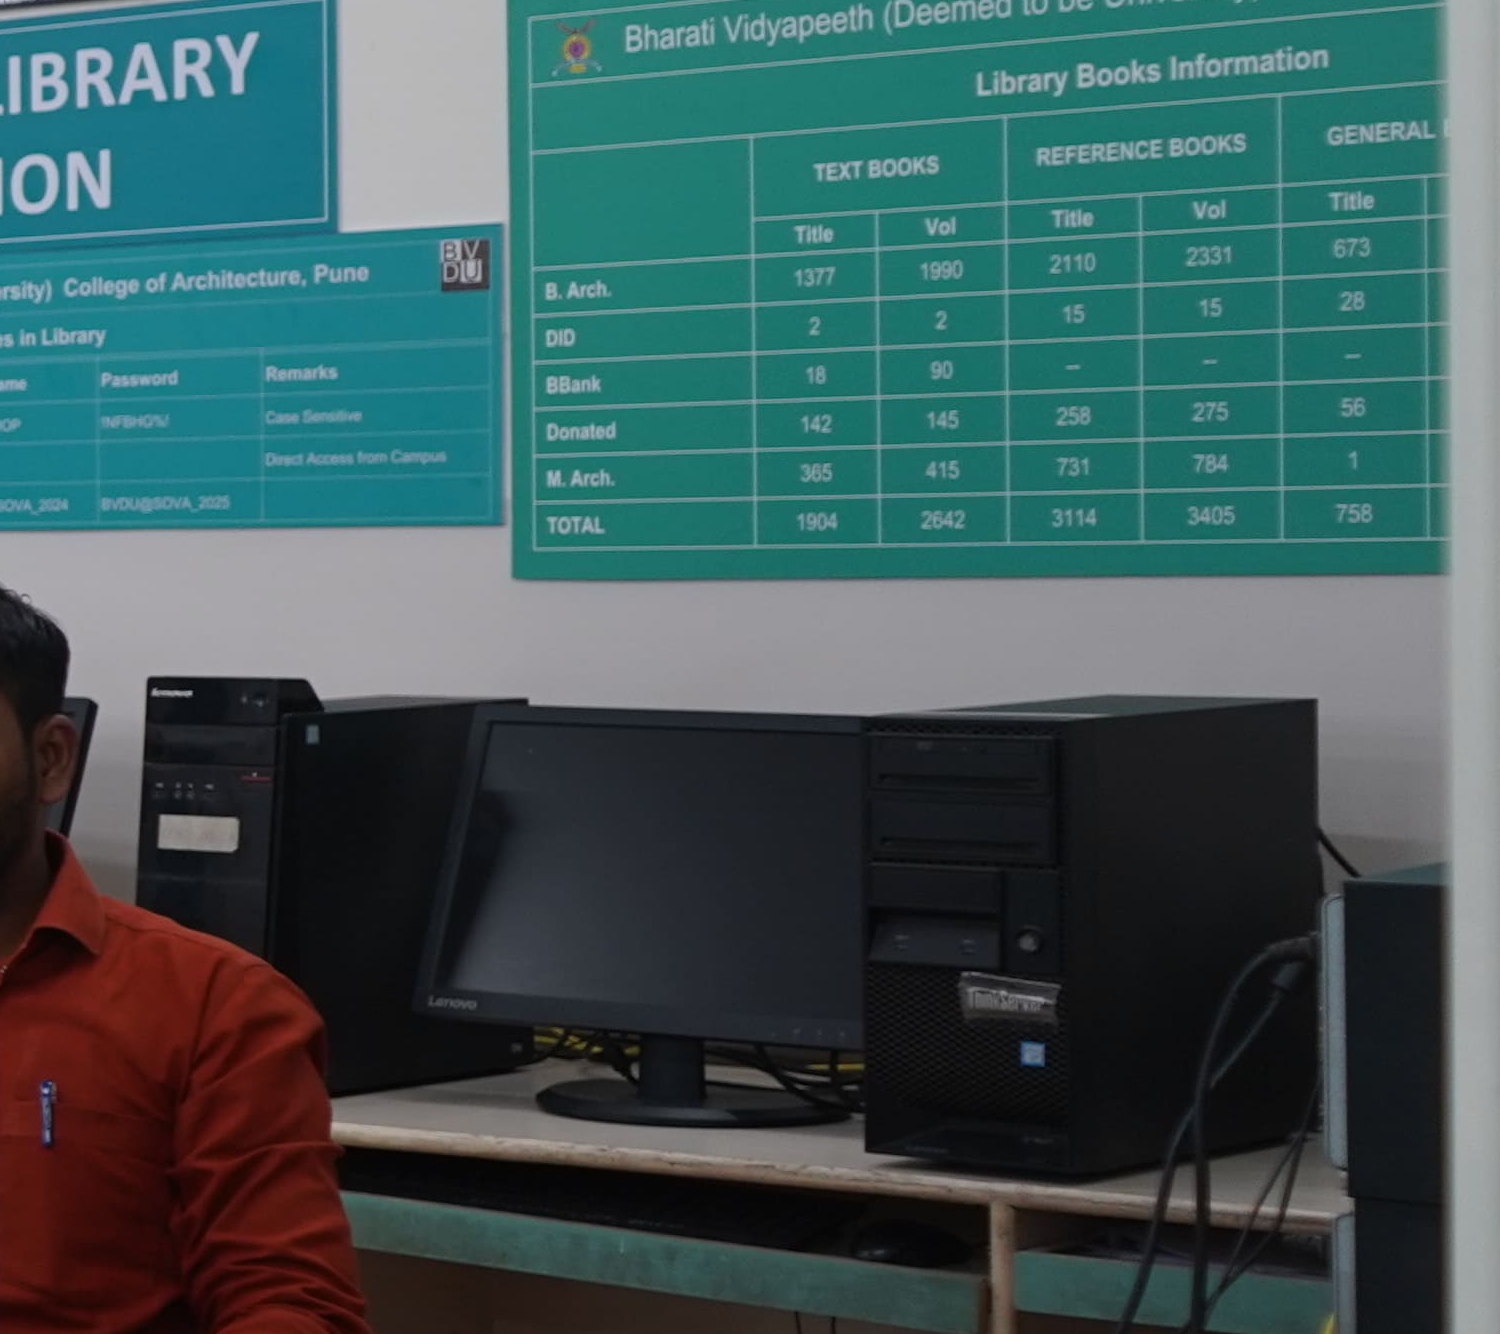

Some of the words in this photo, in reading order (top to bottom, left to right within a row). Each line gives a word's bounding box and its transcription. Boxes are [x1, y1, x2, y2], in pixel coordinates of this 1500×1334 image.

[624, 19, 717, 53] Bharati
[722, 1, 875, 47] Vidyapeeth
[975, 68, 1069, 98] Library
[1076, 59, 1163, 90] Books
[1169, 45, 1331, 82] Information
[1326, 118, 1437, 146] GENERAL
[1035, 138, 1164, 167] REFERENCE
[1168, 132, 1248, 159] BOOKS
[812, 160, 865, 183] TEXT
[867, 155, 941, 180] BOOKS
[1192, 199, 1228, 220] Vol
[1327, 190, 1376, 212] Title
[923, 216, 957, 237] Vol
[1050, 207, 1095, 229] Title
[793, 223, 834, 245] Title
[1185, 245, 1233, 268] 2331
[1332, 237, 1372, 259] 673
[920, 259, 964, 281] 1990
[1049, 252, 1097, 275] 2110
[62, 276, 139, 303] College
[145, 271, 167, 295] of
[170, 265, 308, 292] Architecture,
[313, 262, 370, 285] Pune
[794, 266, 836, 288] 1377
[544, 281, 563, 301] B.
[566, 278, 613, 300] Arch.
[1198, 297, 1223, 319] 15
[1340, 290, 1366, 312] 28
[934, 310, 949, 331] 2
[1062, 304, 1086, 325] 15
[808, 316, 821, 337] 2
[19, 328, 37, 347] in
[41, 326, 107, 351] Library
[544, 328, 576, 348] DID
[101, 370, 179, 389] Password
[265, 364, 339, 383] Remarks
[805, 365, 828, 385] 18
[929, 360, 954, 381] 90
[544, 373, 602, 395] BBank
[265, 408, 299, 425] Case
[301, 406, 362, 424] Sensitive
[1055, 405, 1092, 427] 258
[1191, 400, 1230, 423] 275
[1339, 396, 1367, 418] 56
[799, 414, 833, 435] 142
[926, 409, 960, 430] 145
[545, 421, 617, 442] Donated
[265, 451, 303, 467] Direct
[305, 450, 355, 466] Access
[357, 448, 388, 465] from
[390, 447, 448, 466] Campus
[1056, 457, 1091, 478] 731
[1192, 452, 1230, 474] 784
[1348, 450, 1359, 471] 1
[545, 470, 567, 488] M.
[569, 468, 616, 488] Arch.
[925, 460, 961, 480] 415
[796, 512, 839, 532] 1904
[920, 509, 966, 531] 2642
[1051, 505, 1098, 528] 3114
[1186, 504, 1236, 527] 3405
[1334, 503, 1374, 524] 758
[547, 515, 606, 535] TOTAL
[427, 993, 478, 1011] Lenovo
